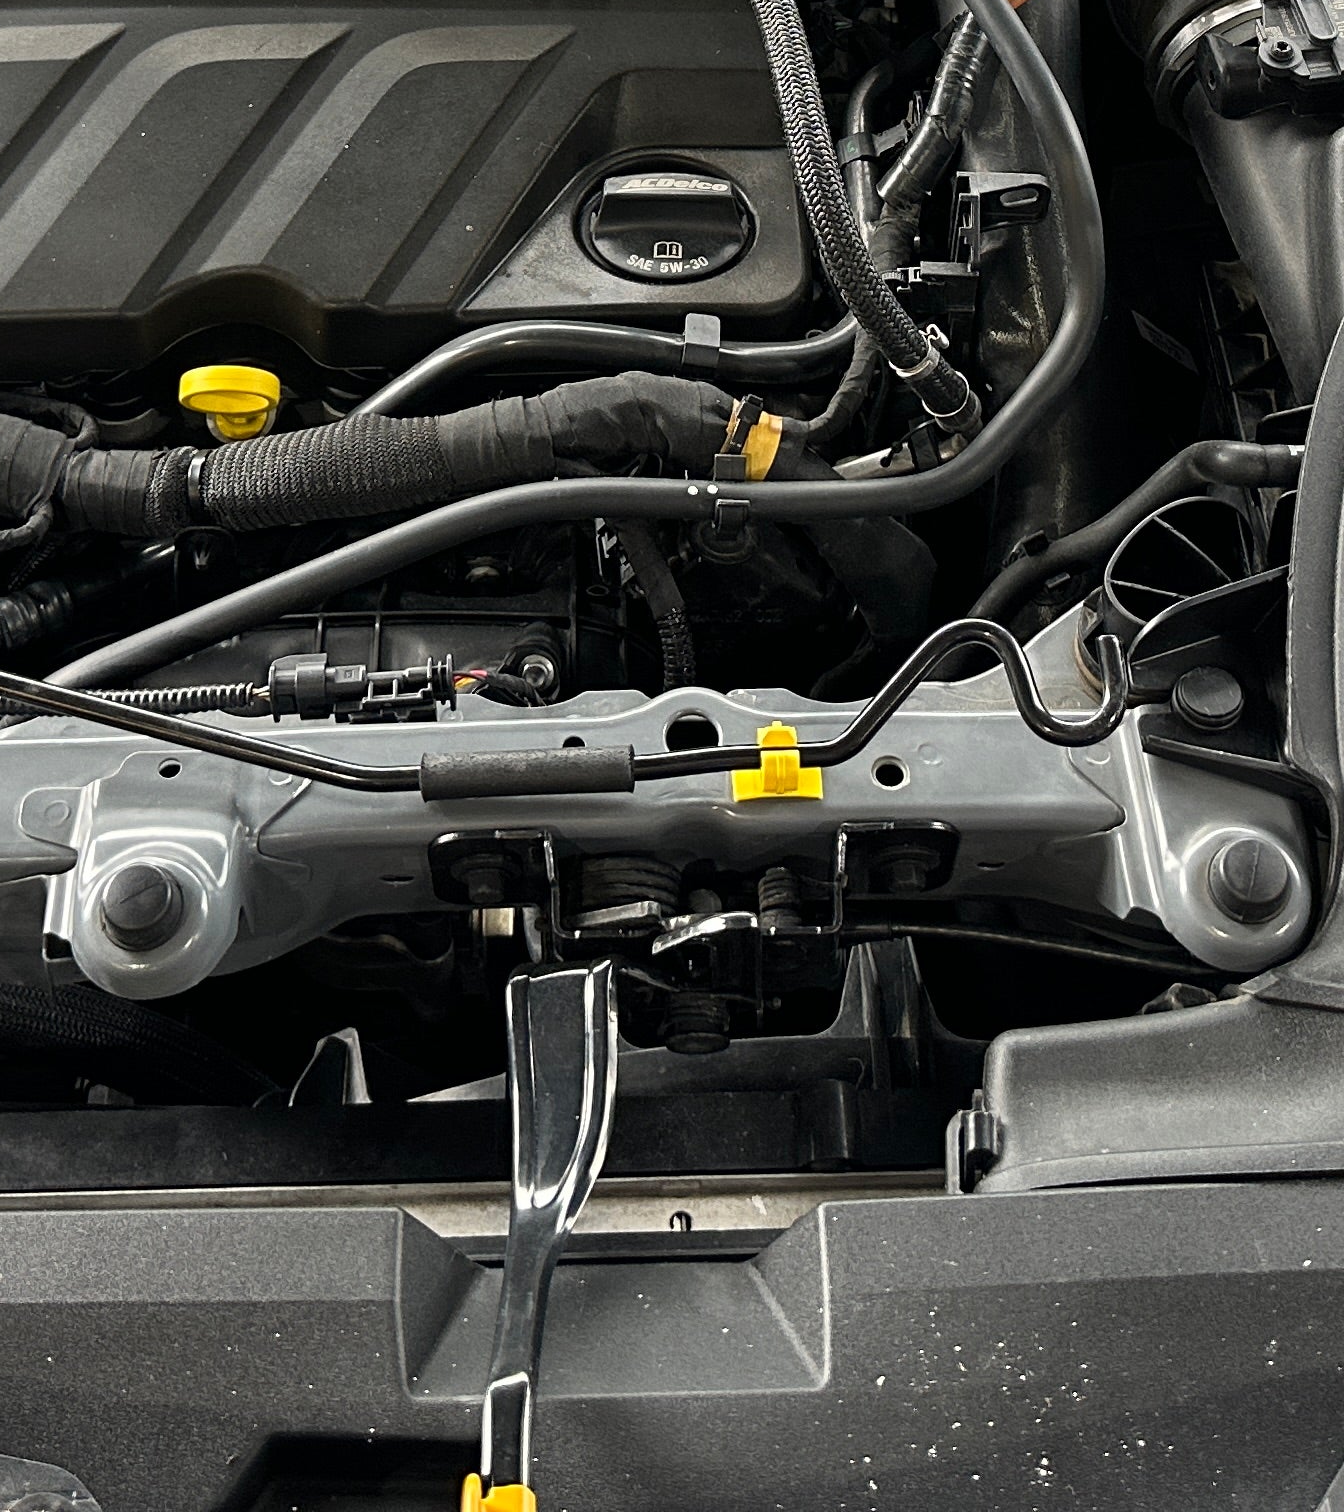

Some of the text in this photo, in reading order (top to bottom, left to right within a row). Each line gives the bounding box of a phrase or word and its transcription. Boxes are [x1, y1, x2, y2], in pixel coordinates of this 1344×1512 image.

[621, 178, 729, 192] ACDelco
[627, 254, 709, 273] SAE 5W-30
